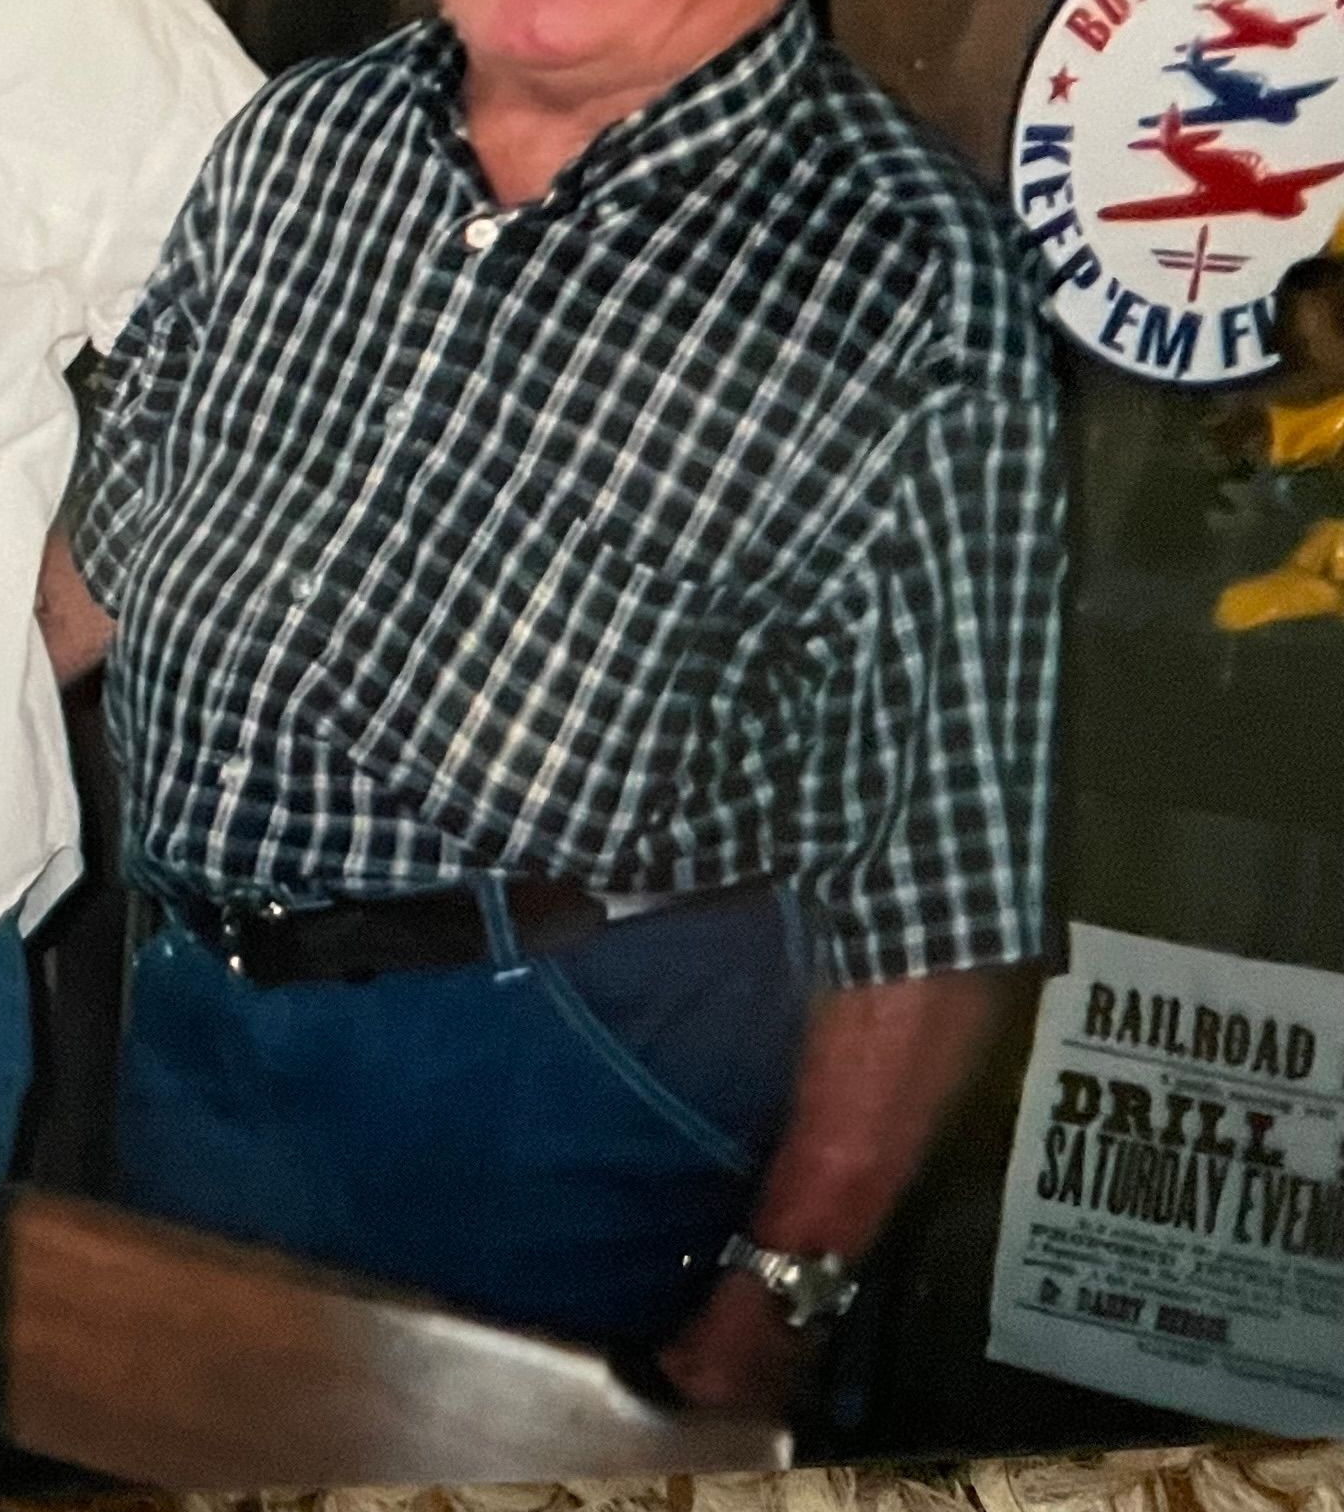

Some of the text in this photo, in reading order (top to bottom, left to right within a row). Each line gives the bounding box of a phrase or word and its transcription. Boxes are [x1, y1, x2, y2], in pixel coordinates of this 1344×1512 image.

[1019, 124, 1102, 289] KEEP
[1085, 981, 1316, 1080] RAILROAD
[1050, 1069, 1287, 1169] DRILL
[1036, 1126, 1230, 1236] SATURDAY
